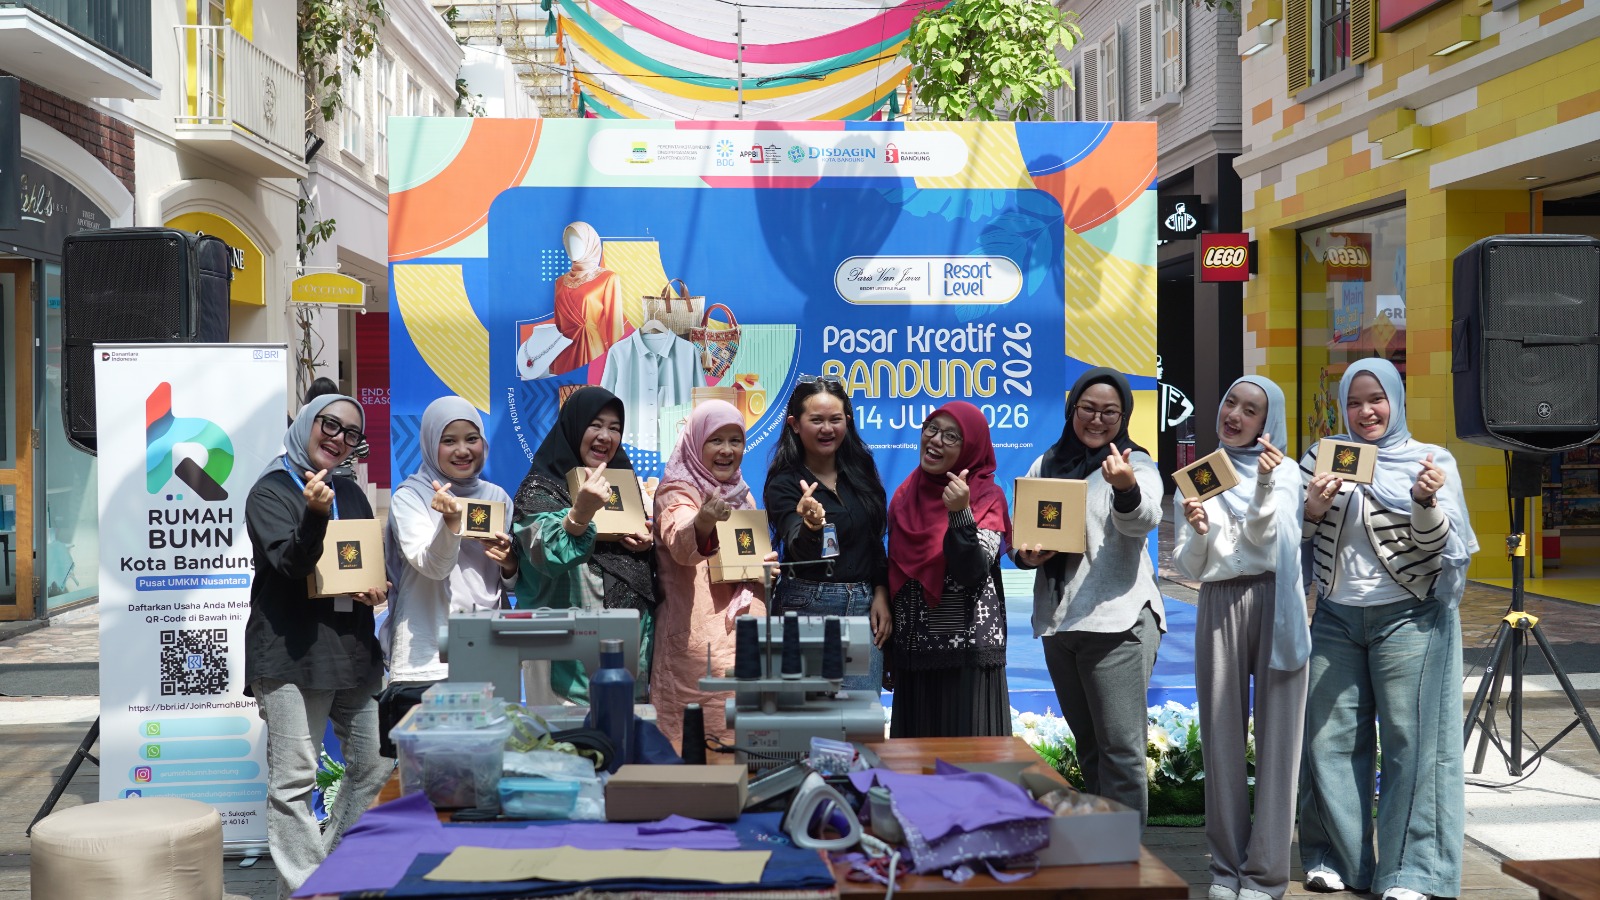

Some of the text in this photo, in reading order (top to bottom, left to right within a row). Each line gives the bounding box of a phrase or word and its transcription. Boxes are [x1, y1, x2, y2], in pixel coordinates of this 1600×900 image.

[808, 147, 876, 158] DISDAGIN
[716, 158, 734, 166] BDG
[1204, 247, 1246, 267] LEGO
[847, 267, 920, 286] Paris Van Java
[944, 262, 992, 279] Resort
[944, 279, 984, 296] Level
[1343, 287, 1363, 306] Main
[823, 322, 996, 354] Pasar Kreatif
[264, 350, 278, 358] BRI
[1002, 322, 1032, 397] 2026
[822, 359, 997, 398] BANDUNG
[362, 388, 384, 396] END
[889, 404, 936, 429] JU
[982, 404, 1029, 428] 026
[508, 388, 519, 424] FASHION
[516, 433, 534, 464] AKSES
[743, 436, 764, 454] KANAN
[148, 508, 232, 525] RUMAH
[149, 528, 233, 549] BUMN
[120, 557, 166, 572] Kota
[139, 576, 247, 588] Pusat UMKM Nusantara
[128, 603, 172, 612] Daftarkan
[146, 615, 186, 624] QR-Code
[199, 614, 227, 622] Bawah
